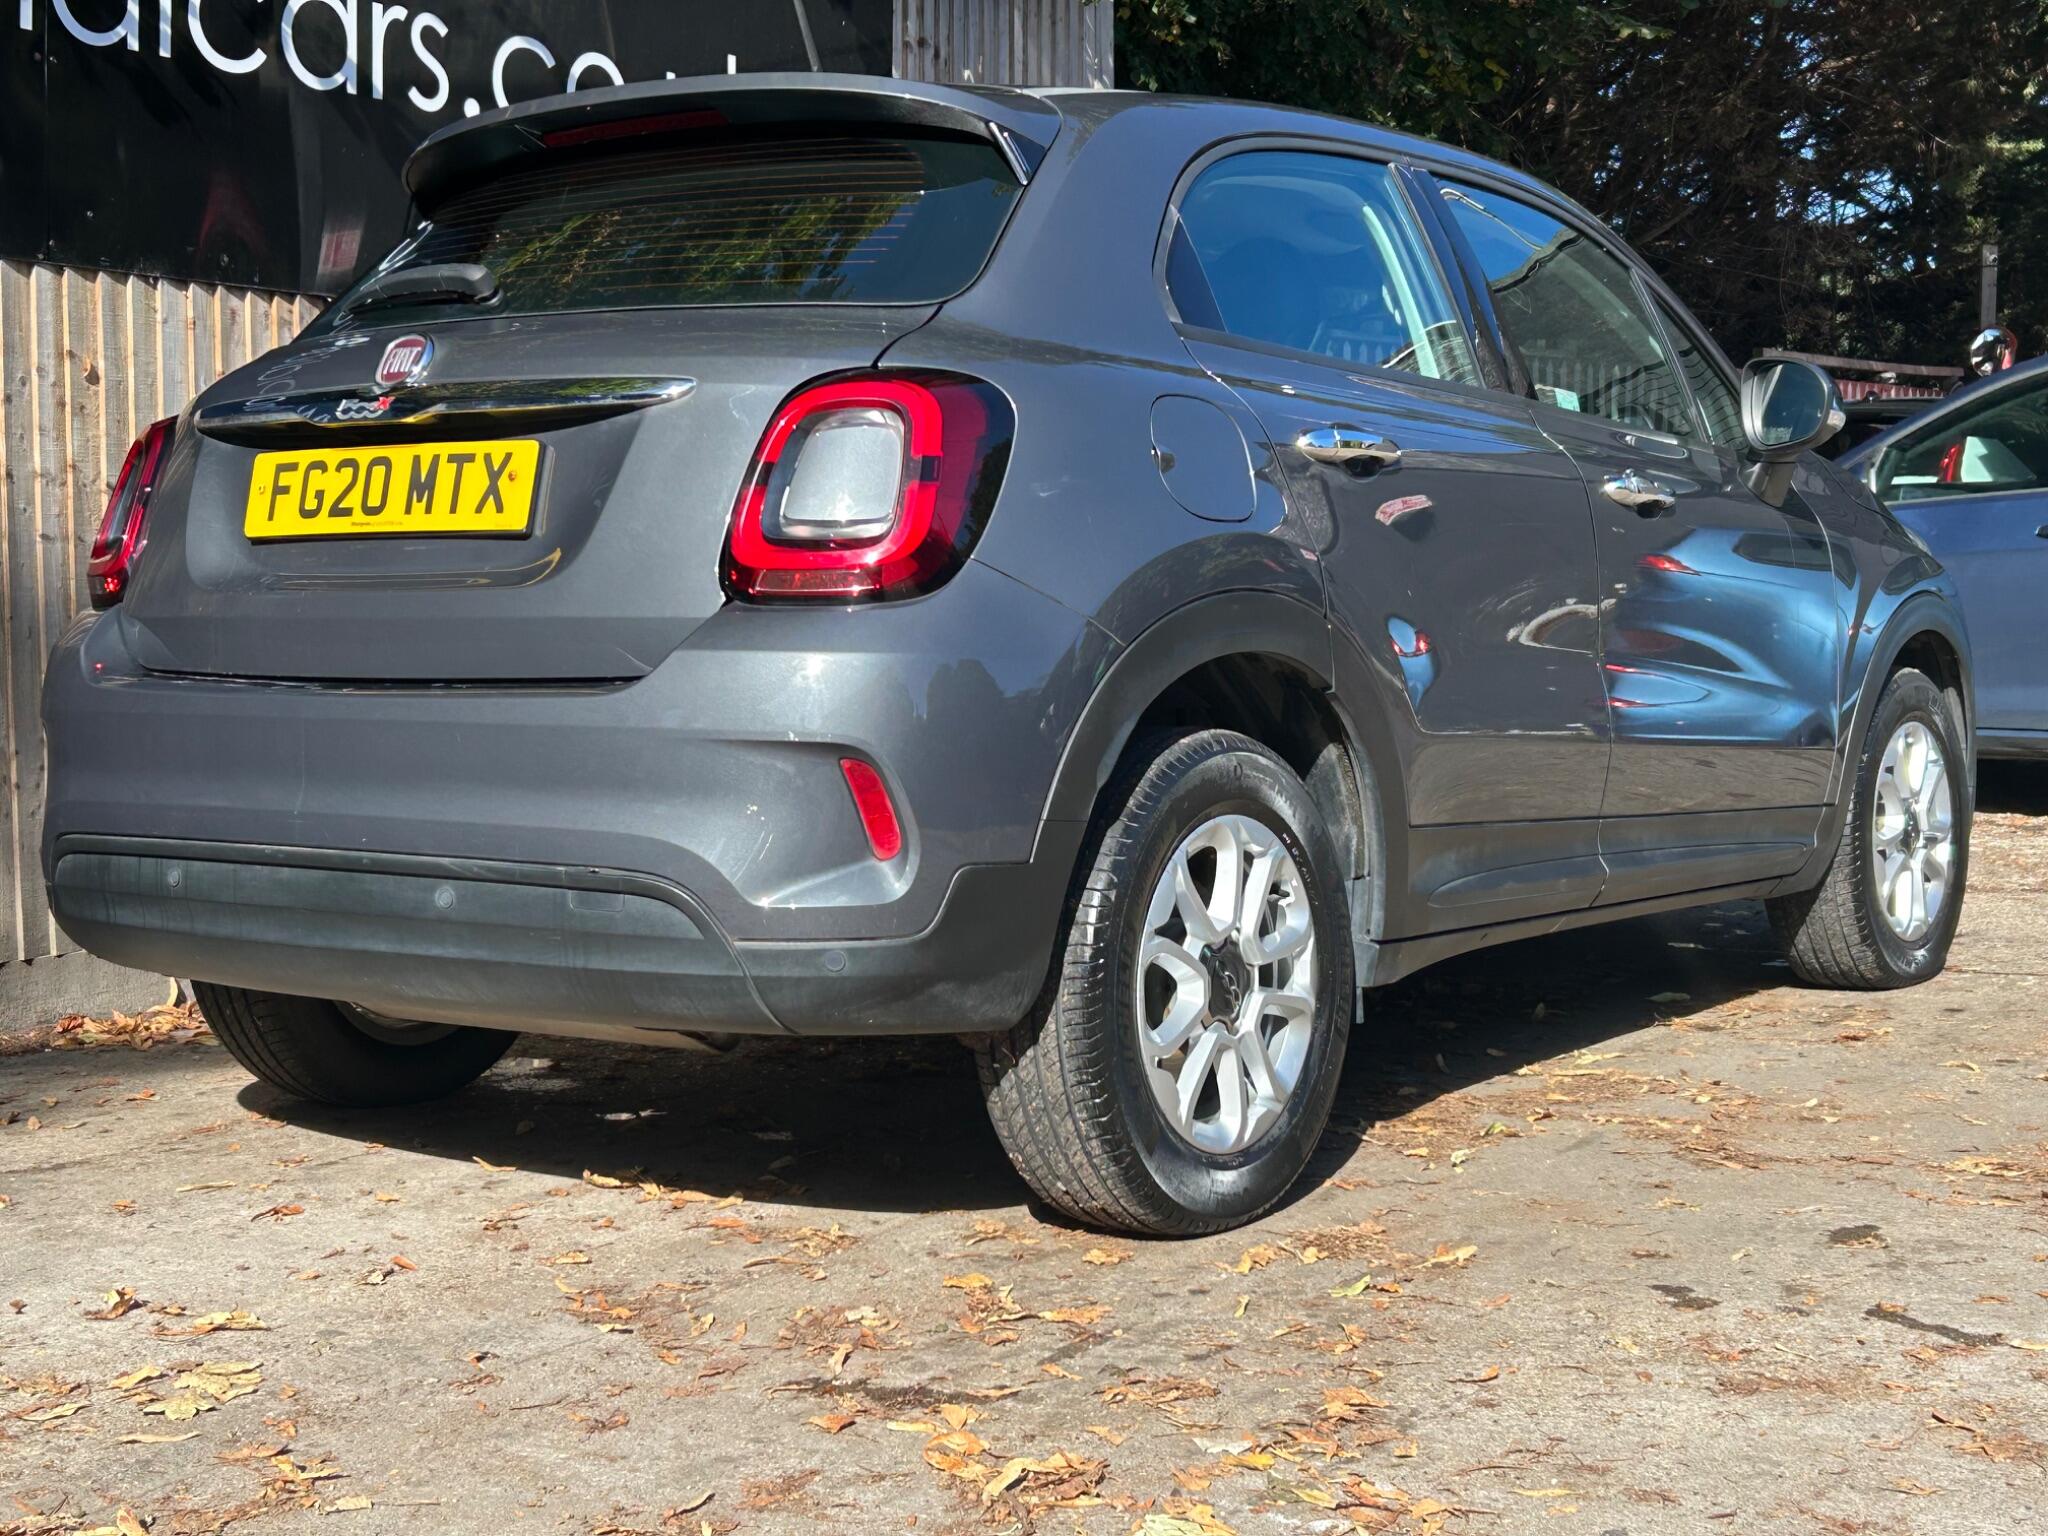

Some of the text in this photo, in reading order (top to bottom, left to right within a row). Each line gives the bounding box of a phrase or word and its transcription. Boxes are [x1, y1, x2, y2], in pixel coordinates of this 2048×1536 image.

[382, 346, 422, 375] FIAT
[267, 452, 513, 521] FG20 MTX
